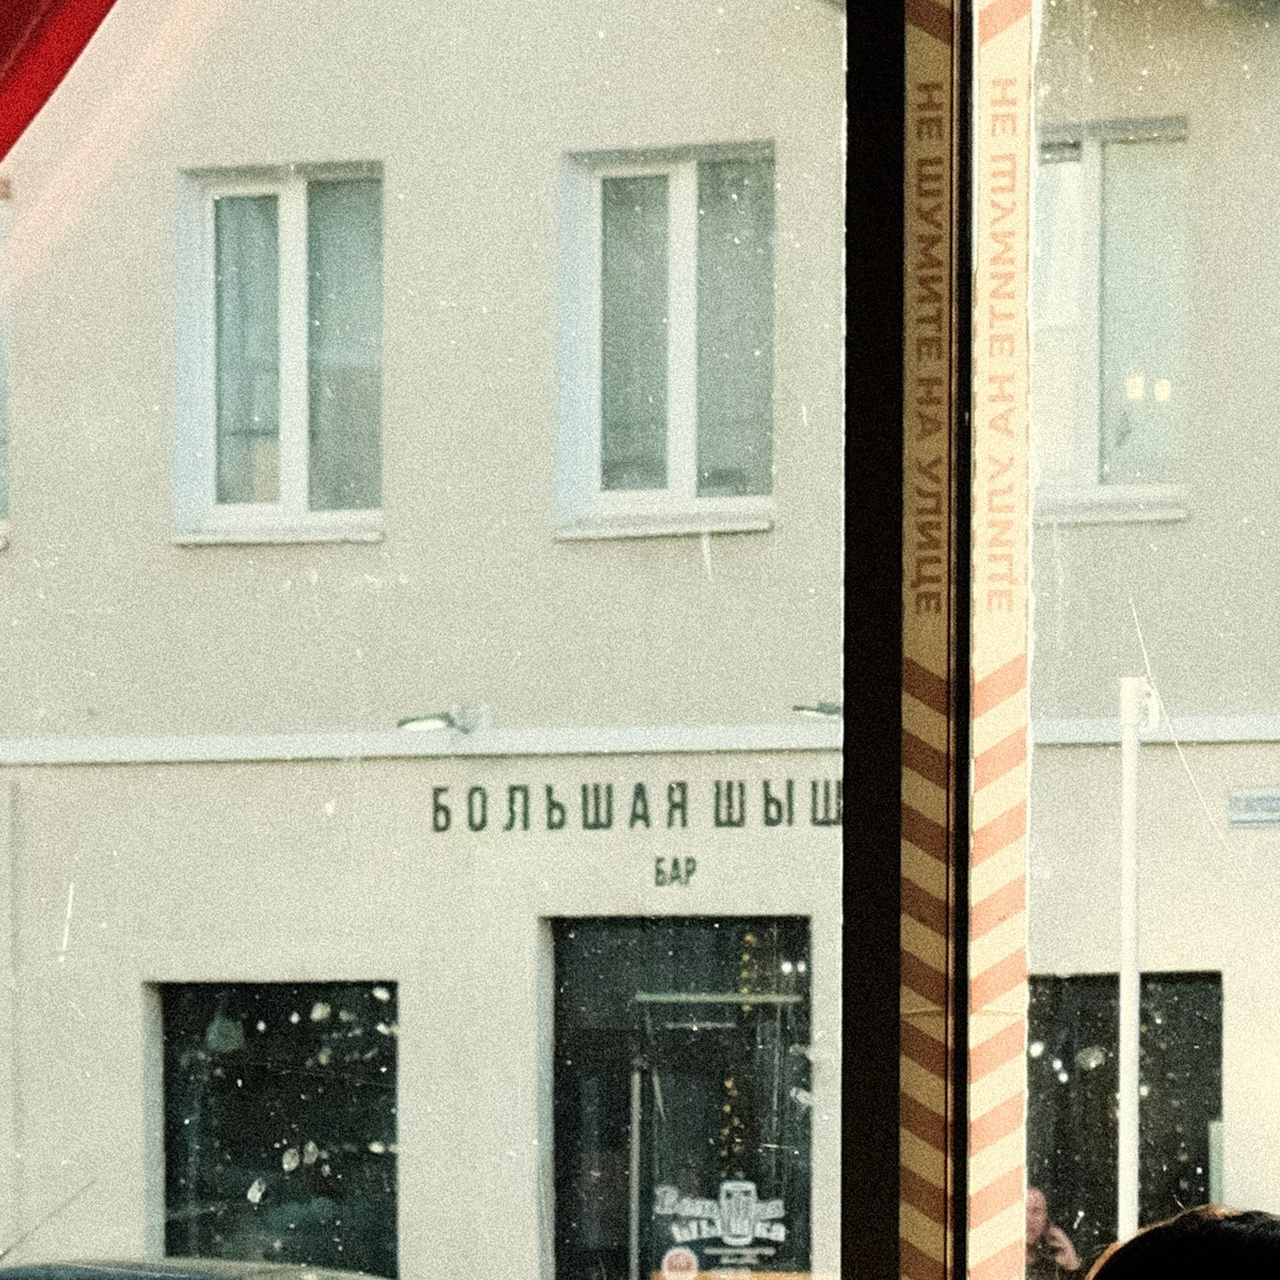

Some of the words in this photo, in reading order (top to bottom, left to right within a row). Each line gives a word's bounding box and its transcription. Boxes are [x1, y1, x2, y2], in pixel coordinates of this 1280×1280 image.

[915, 80, 945, 142] НЕ
[914, 156, 945, 362] ШУМИТЕ
[913, 375, 943, 442] НА
[910, 455, 943, 616] УЛИЦЕ
[432, 781, 690, 832] БОЛЬШАЯ
[654, 856, 698, 887] БАР
